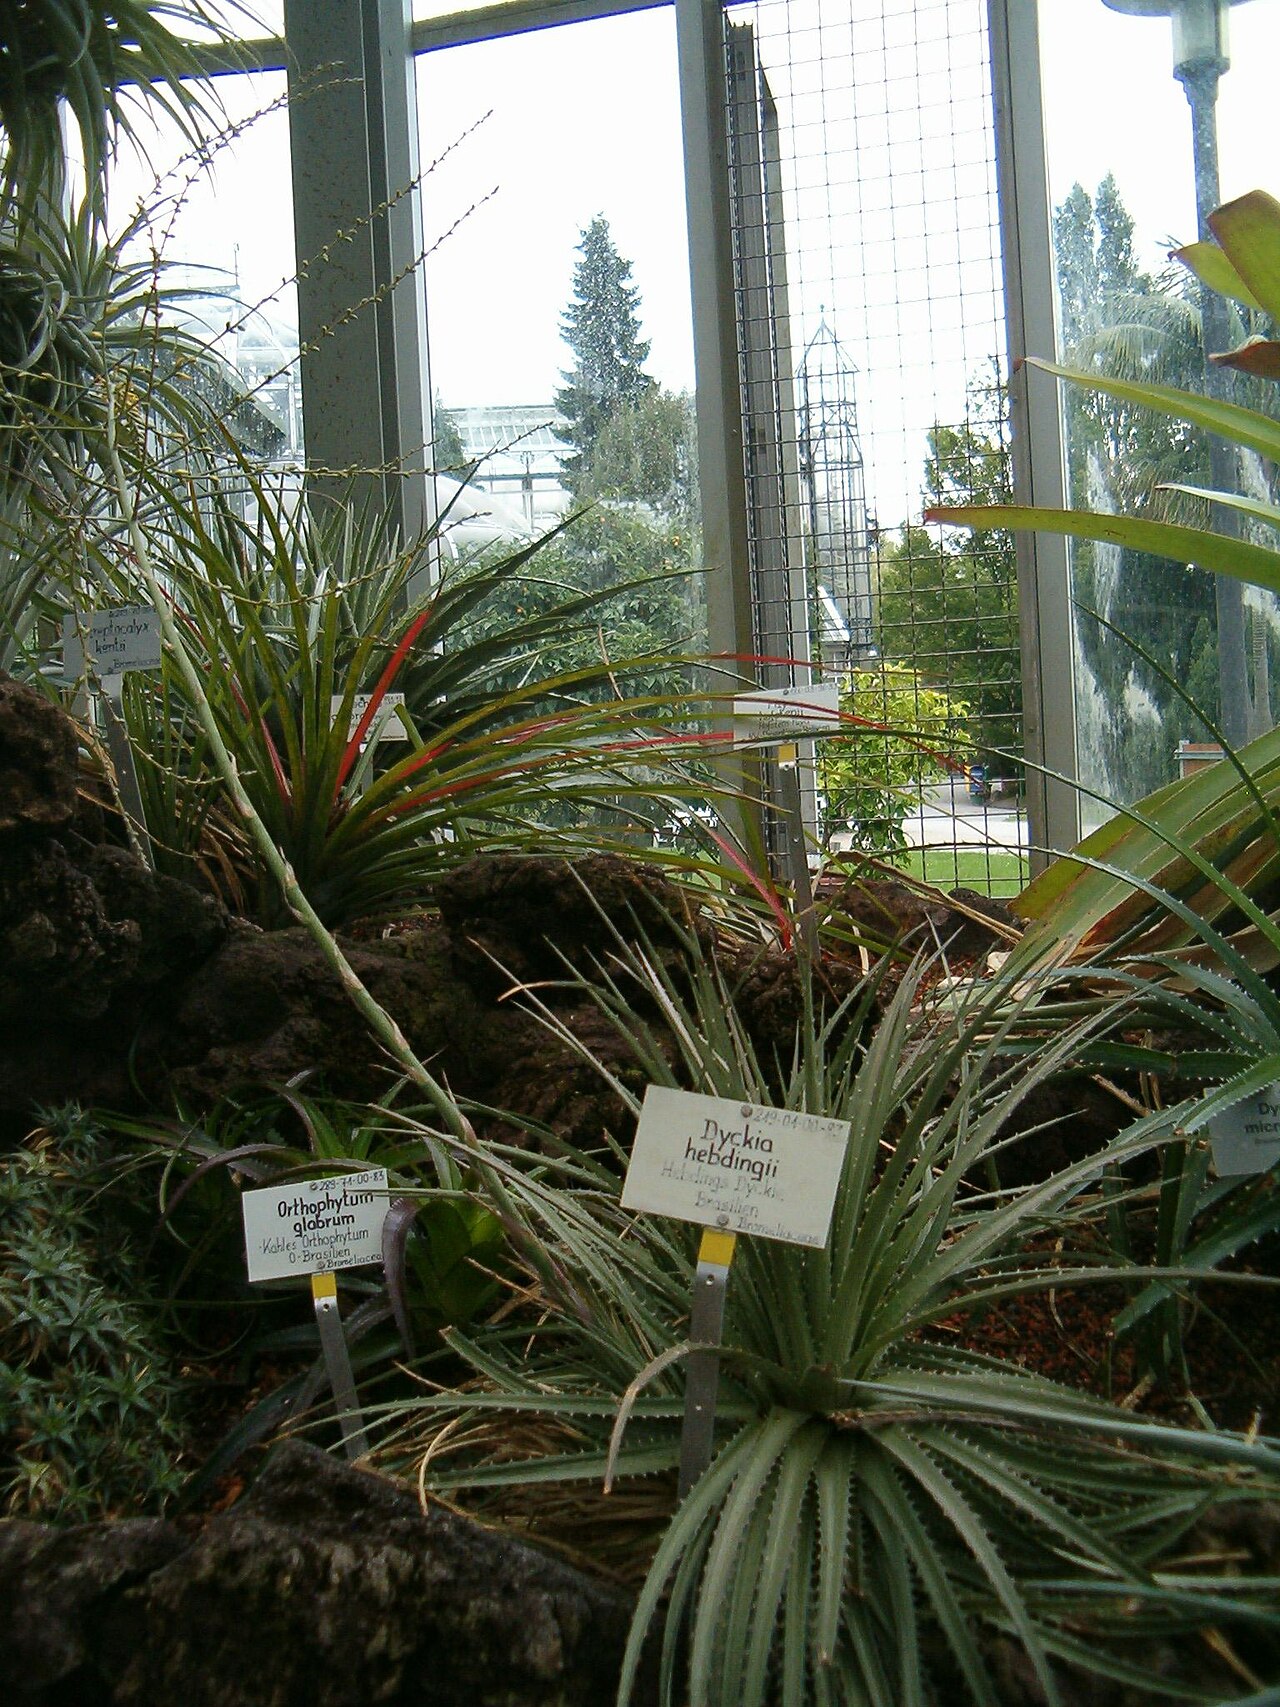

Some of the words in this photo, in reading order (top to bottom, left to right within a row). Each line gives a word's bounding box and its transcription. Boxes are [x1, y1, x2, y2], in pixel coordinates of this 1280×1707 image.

[700, 1117, 774, 1154] Dyckia
[684, 1137, 780, 1182] hebdingii
[277, 1188, 374, 1218] Orthophytum
[694, 1190, 759, 1220] Brasilien
[262, 1237, 297, 1255] Kahles
[302, 1227, 369, 1249] Orthophytum
[293, 1213, 355, 1239] glabrum
